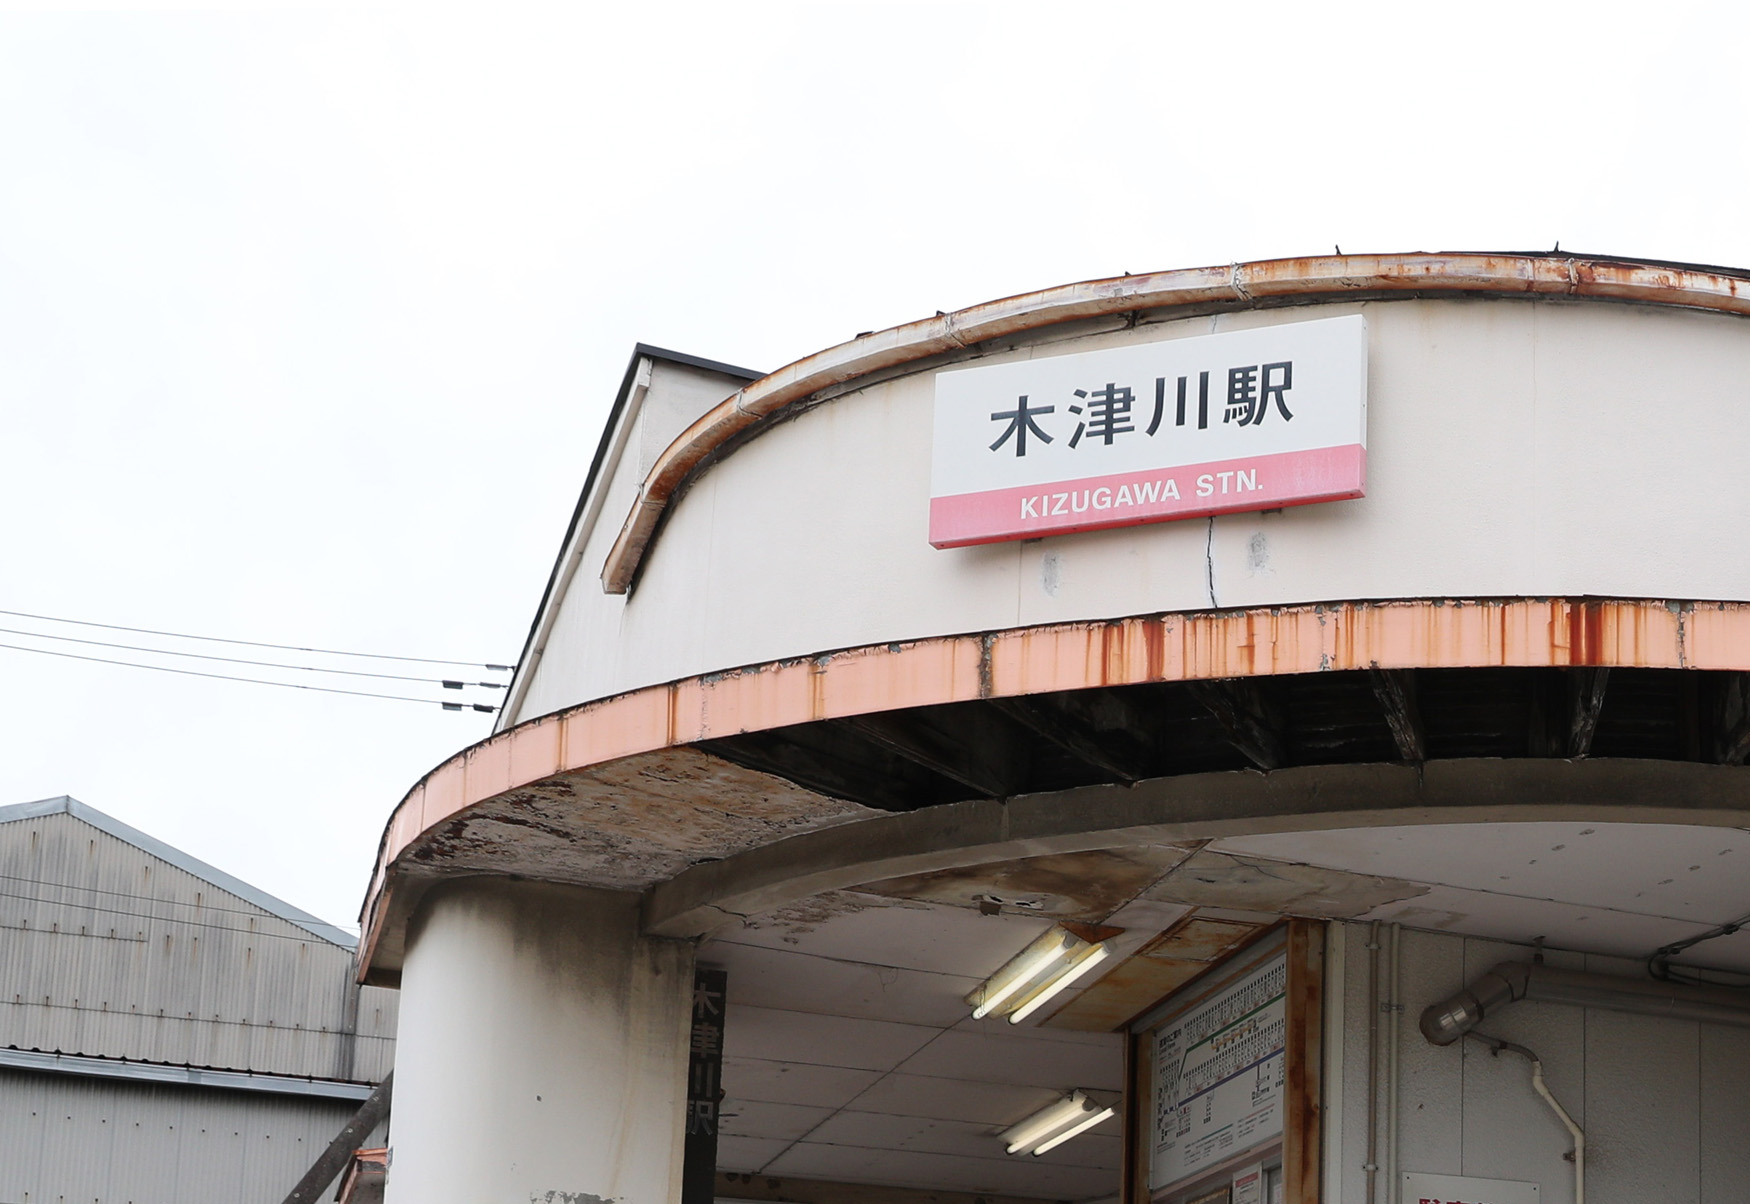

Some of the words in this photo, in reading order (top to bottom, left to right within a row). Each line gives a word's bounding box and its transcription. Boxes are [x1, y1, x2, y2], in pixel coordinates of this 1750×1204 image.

[989, 360, 1294, 457] 木津川駅
[1021, 478, 1181, 519] KIZUGAWA
[1196, 469, 1264, 497] STN.
